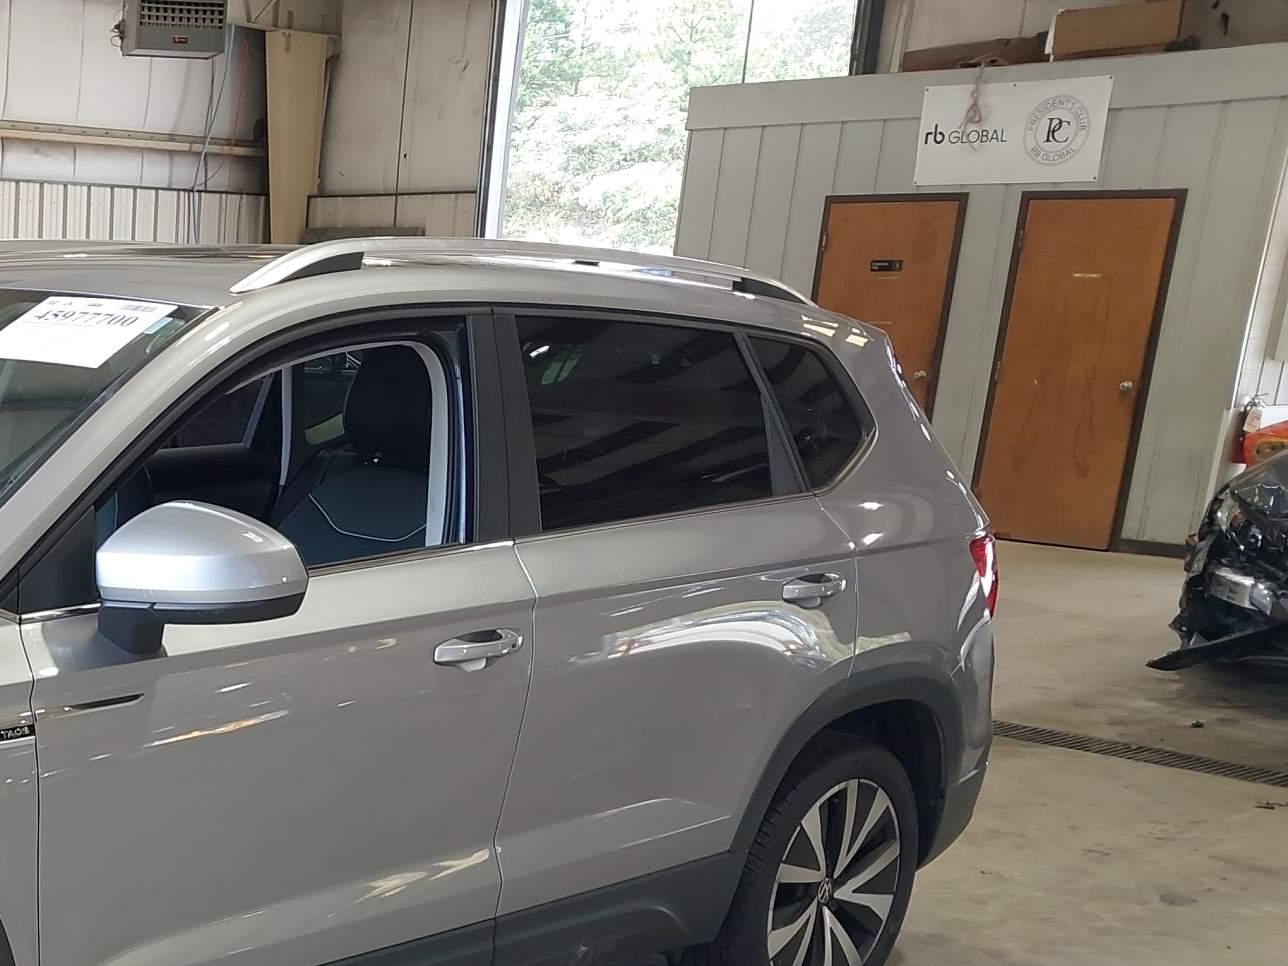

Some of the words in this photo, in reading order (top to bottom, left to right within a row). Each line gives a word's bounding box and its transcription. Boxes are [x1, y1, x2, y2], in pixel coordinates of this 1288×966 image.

[924, 123, 945, 145] rb
[948, 128, 1008, 144] GLOBAL
[34, 309, 139, 327] 45977700
[0, 726, 30, 740] TAOS
